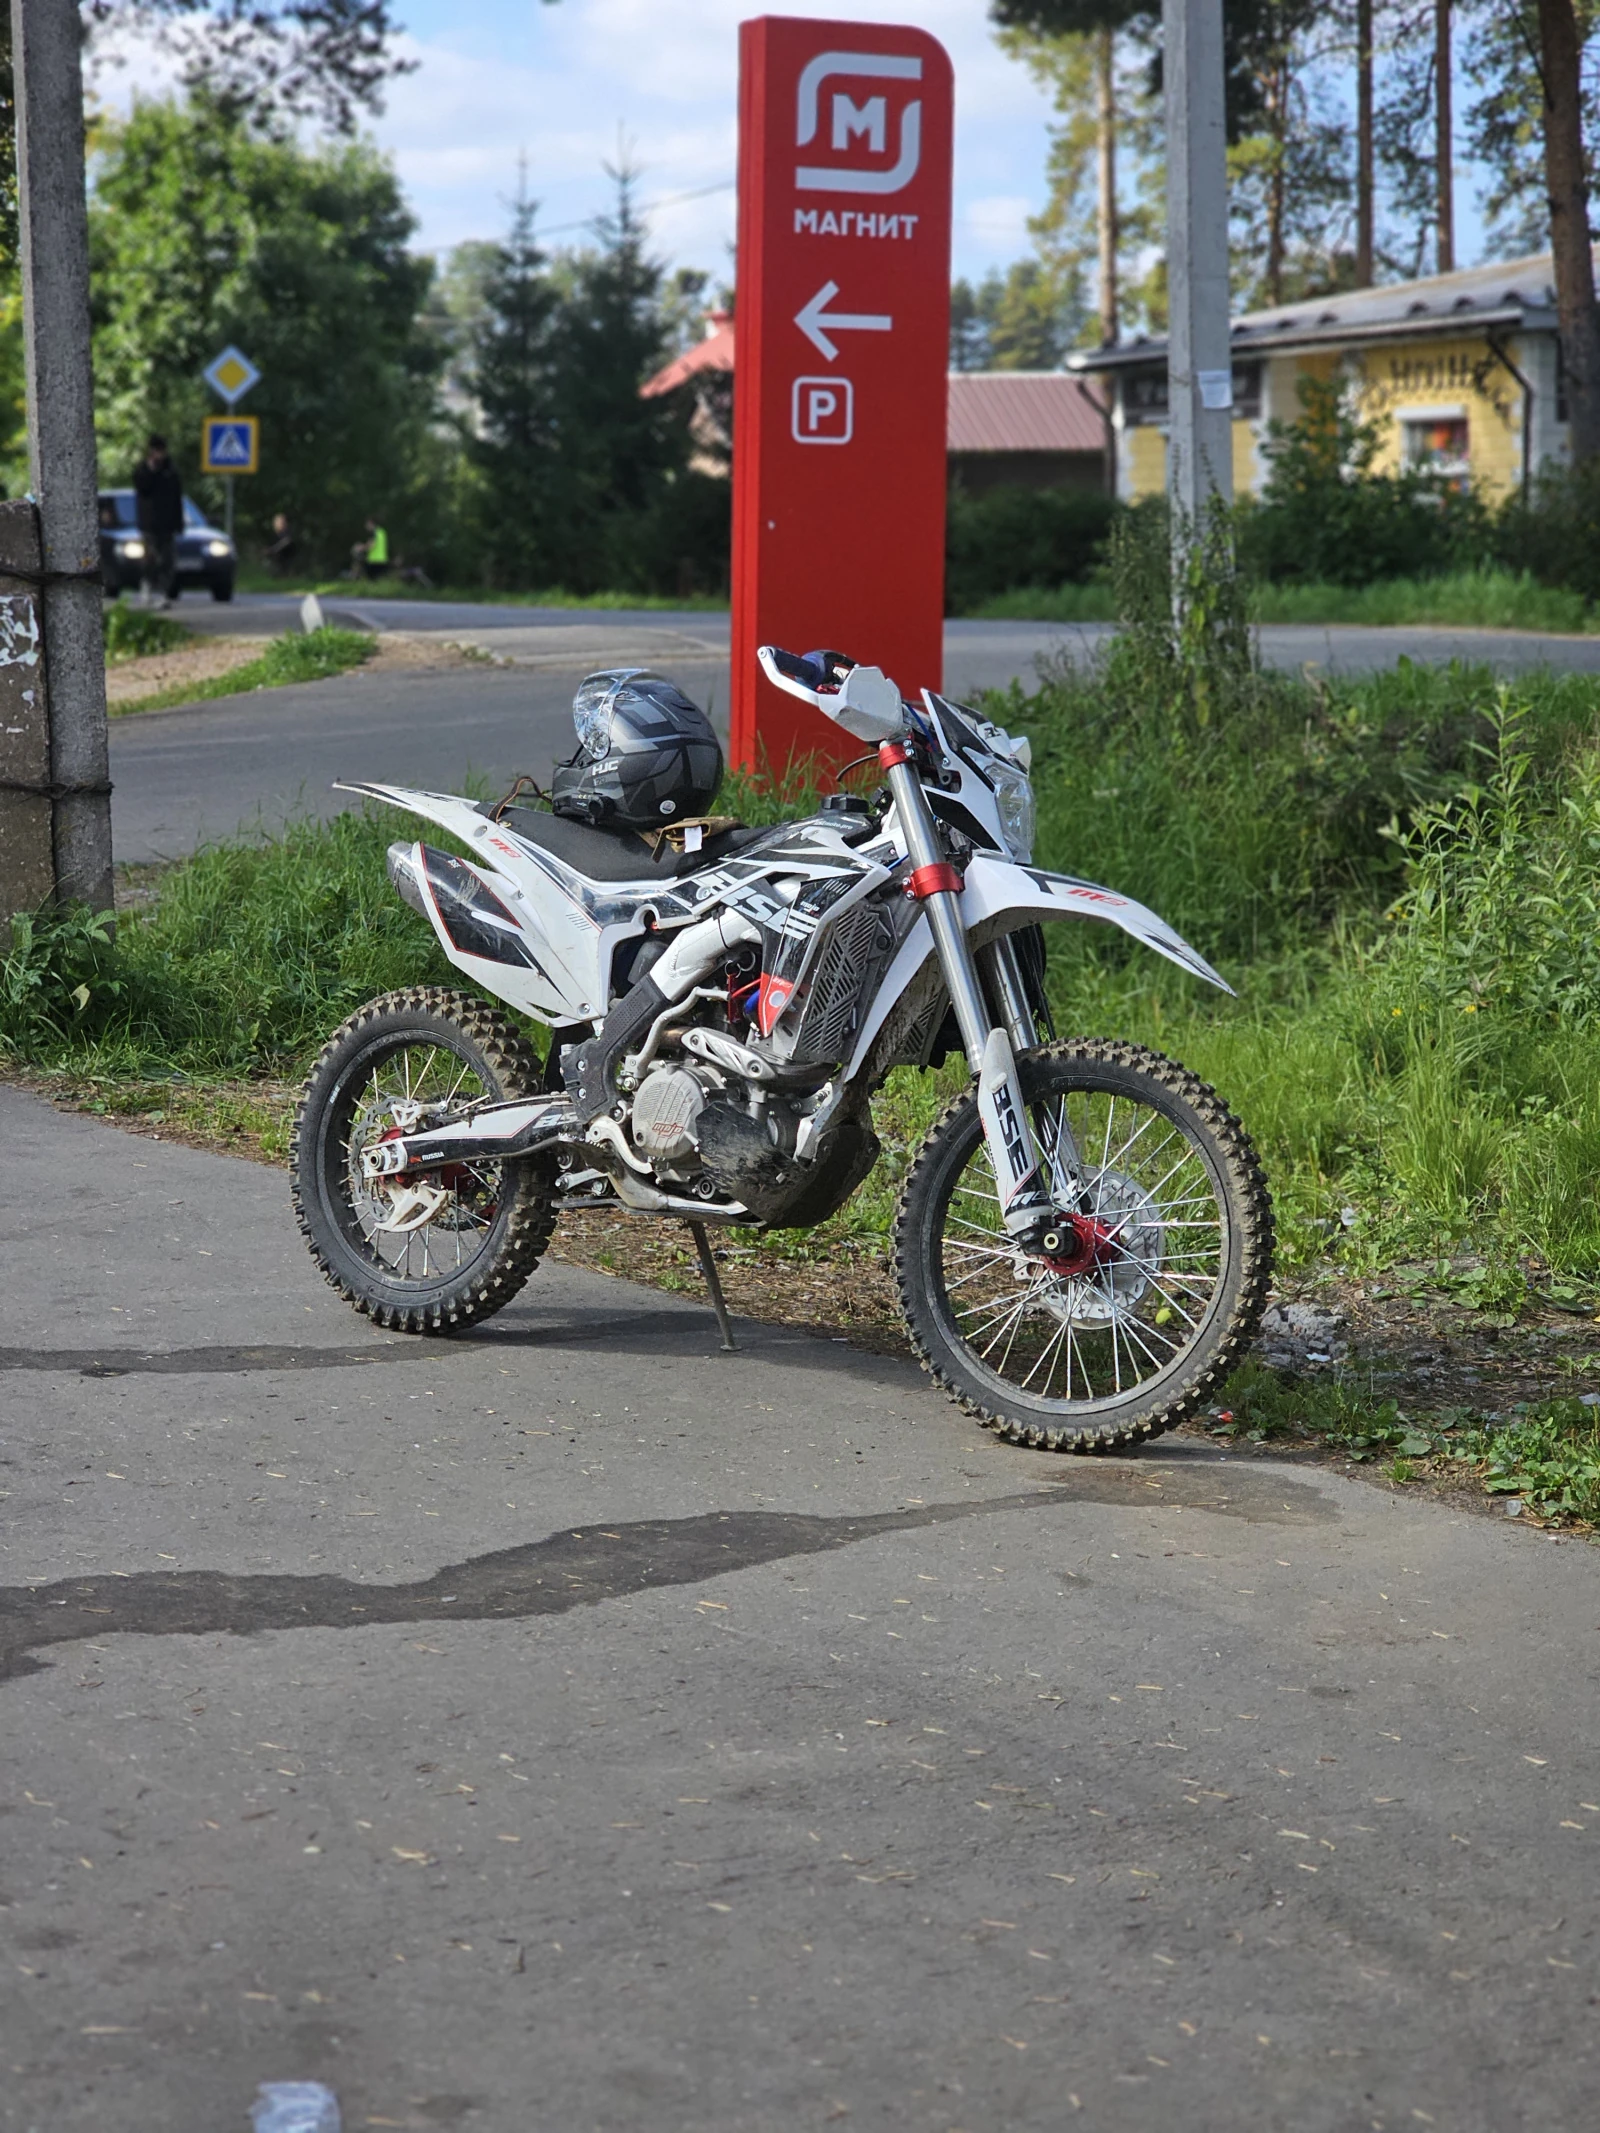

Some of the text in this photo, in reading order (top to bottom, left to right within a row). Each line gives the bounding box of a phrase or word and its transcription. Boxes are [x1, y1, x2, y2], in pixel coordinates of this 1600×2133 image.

[794, 208, 919, 239] МАГНИТ
[808, 390, 837, 431] P
[592, 760, 619, 776] HJC
[992, 1083, 1029, 1183] BSE
[421, 1151, 445, 1162] RUSSIA
